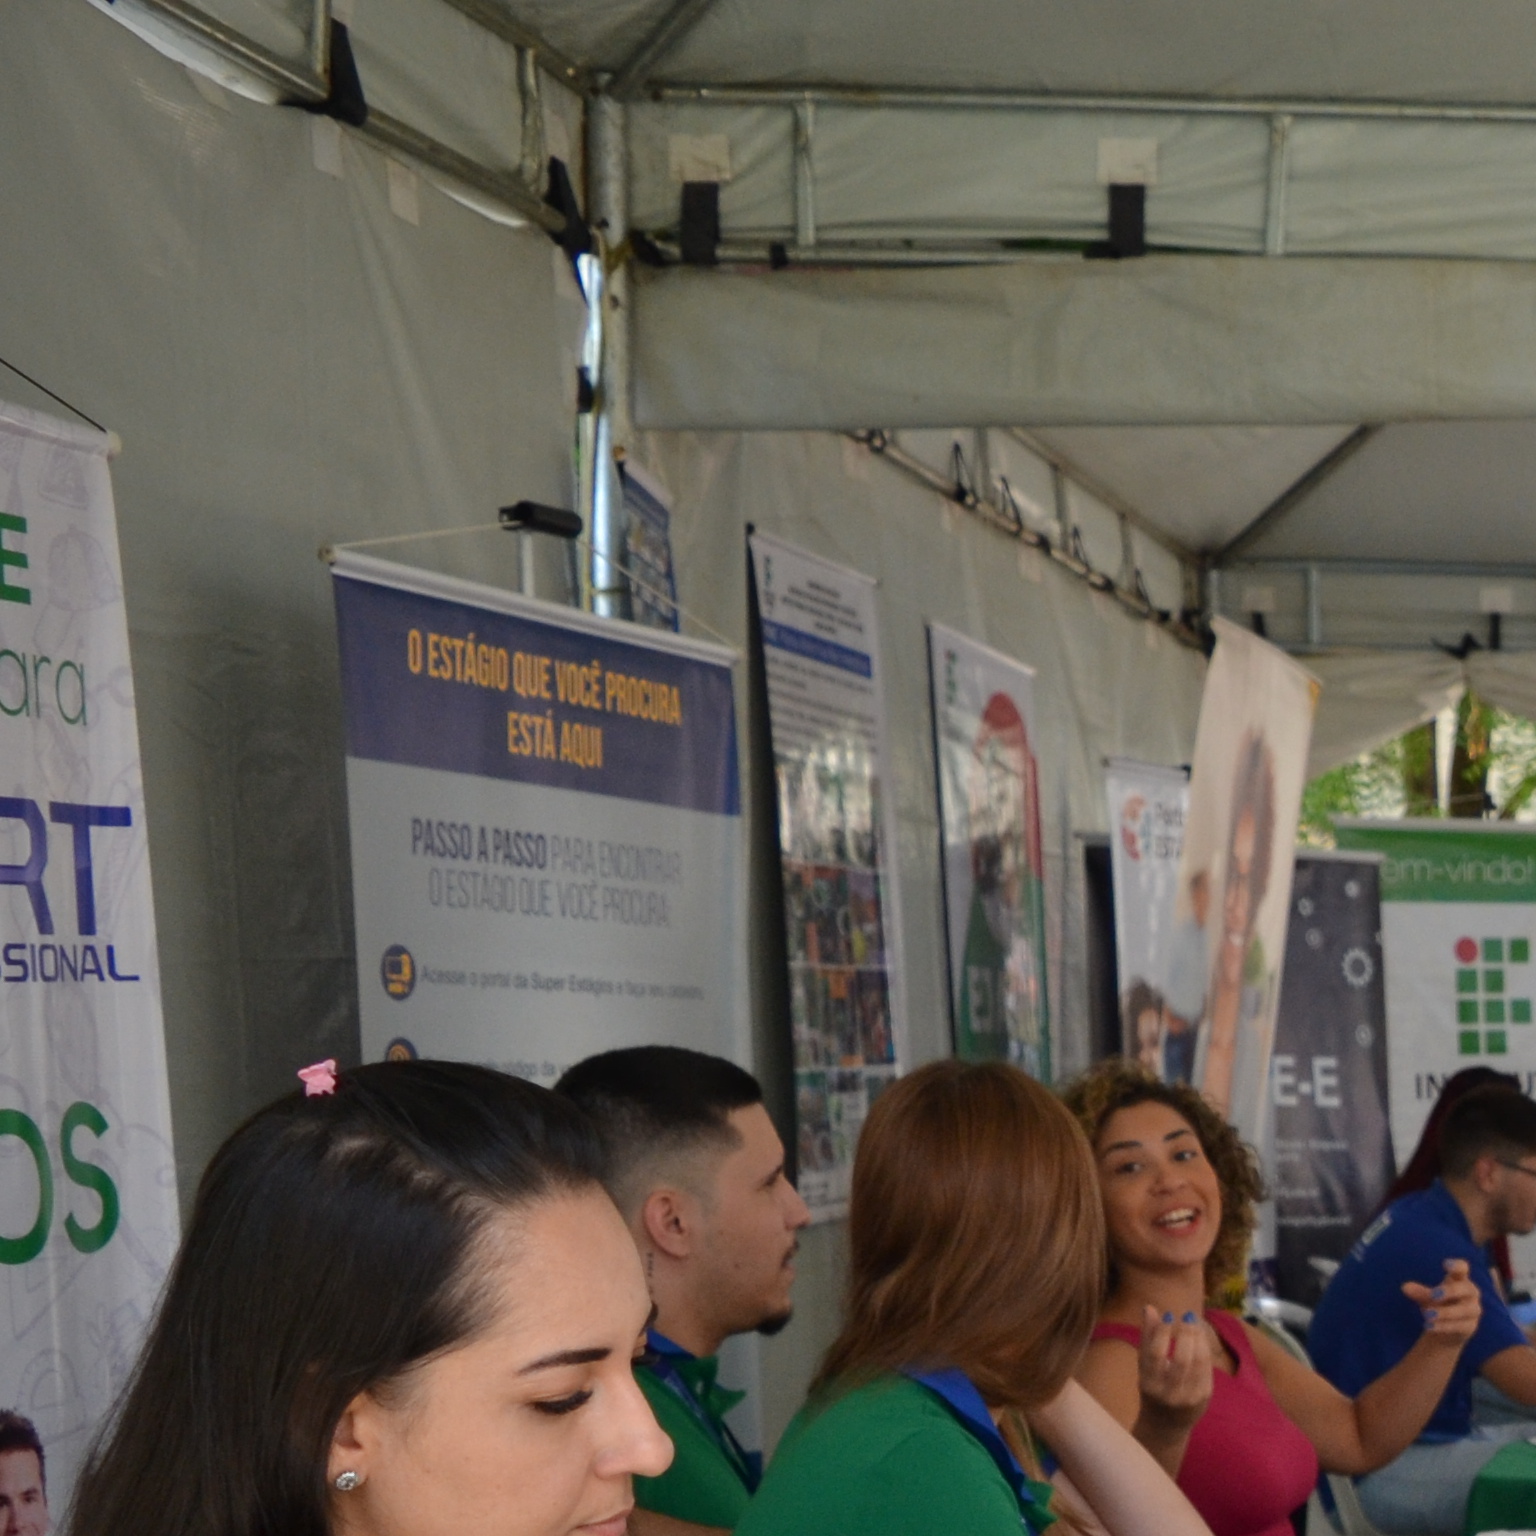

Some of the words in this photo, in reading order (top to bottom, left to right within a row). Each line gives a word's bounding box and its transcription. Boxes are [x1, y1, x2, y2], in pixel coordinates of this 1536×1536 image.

[408, 629, 422, 674] O
[428, 633, 508, 691] ESTÁGIO
[513, 652, 551, 699] QUE
[556, 659, 601, 709] VOCÊ
[606, 671, 682, 726] PROCURA
[508, 709, 556, 760] ESTÁ
[560, 722, 603, 769] AQUI
[411, 817, 472, 860] PASSO
[476, 826, 491, 864] A
[493, 828, 547, 870] PASSO
[1380, 854, 1536, 886] em-vindo!
